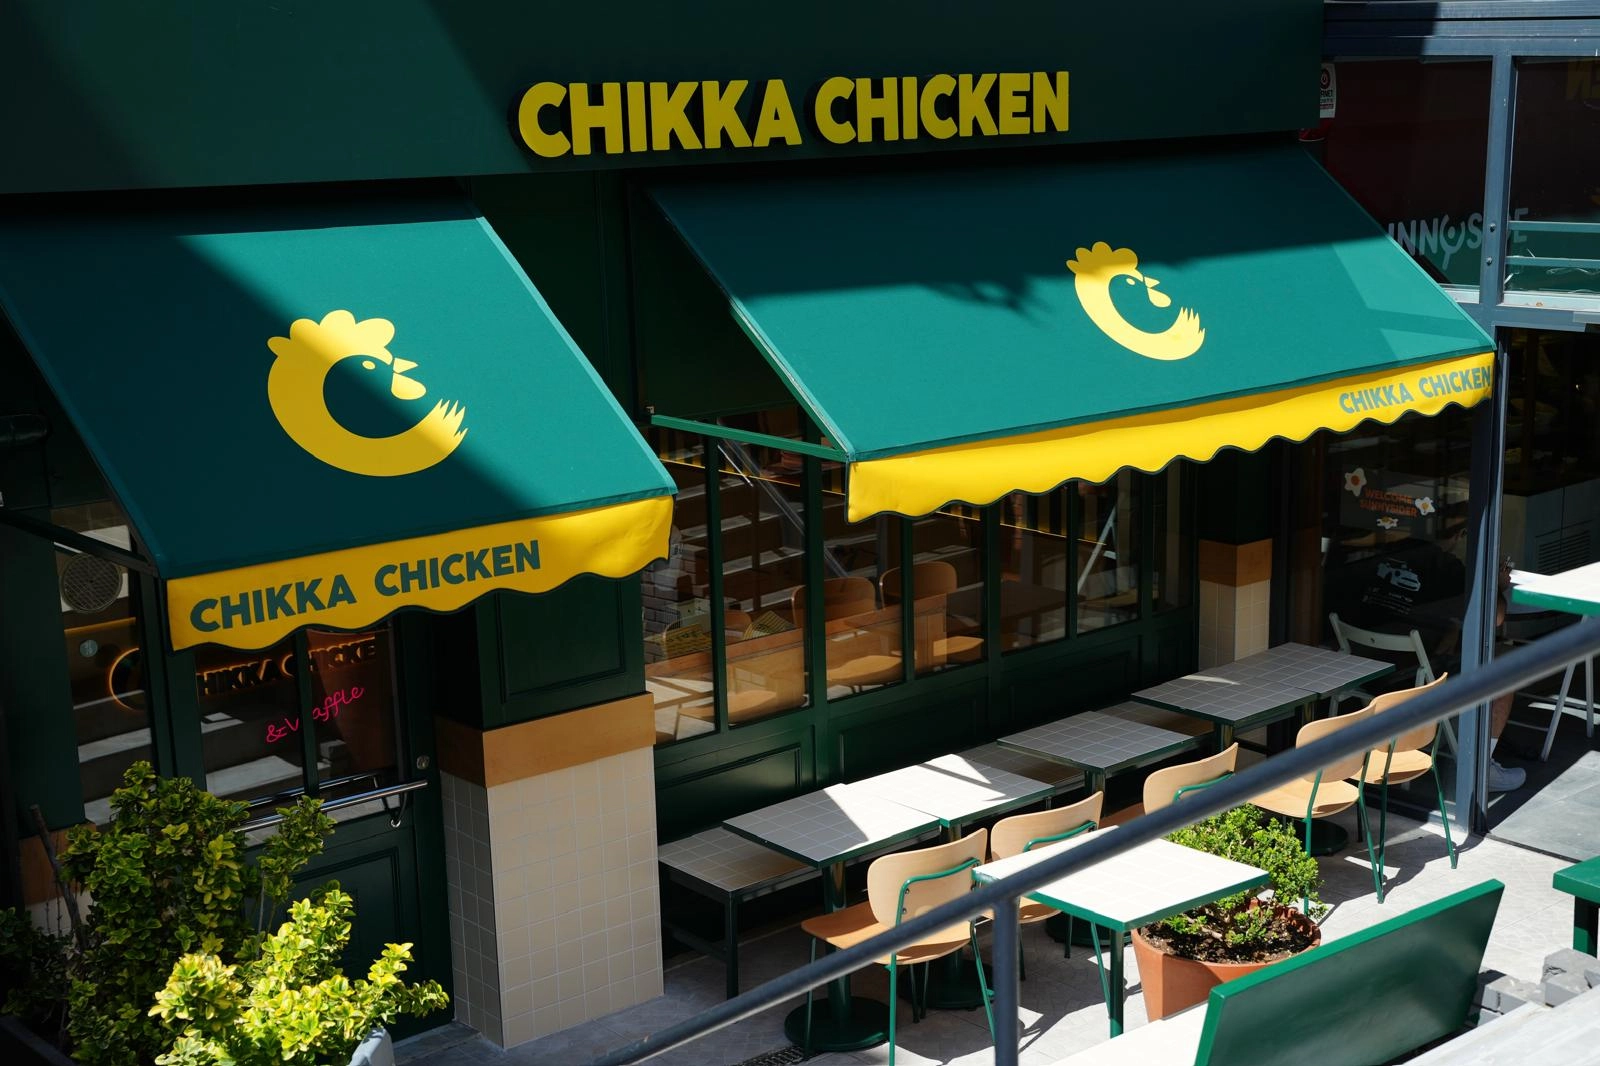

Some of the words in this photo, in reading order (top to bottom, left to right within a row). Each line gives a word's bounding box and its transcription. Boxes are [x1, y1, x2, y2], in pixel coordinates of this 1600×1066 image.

[518, 79, 802, 158] CHIKKA
[815, 71, 1070, 144] CHICKEN
[1339, 383, 1414, 414] CHIKKA
[1418, 366, 1491, 398] CHICKEN
[190, 574, 357, 633] CHIKKA
[374, 539, 541, 597] CHICKEN
